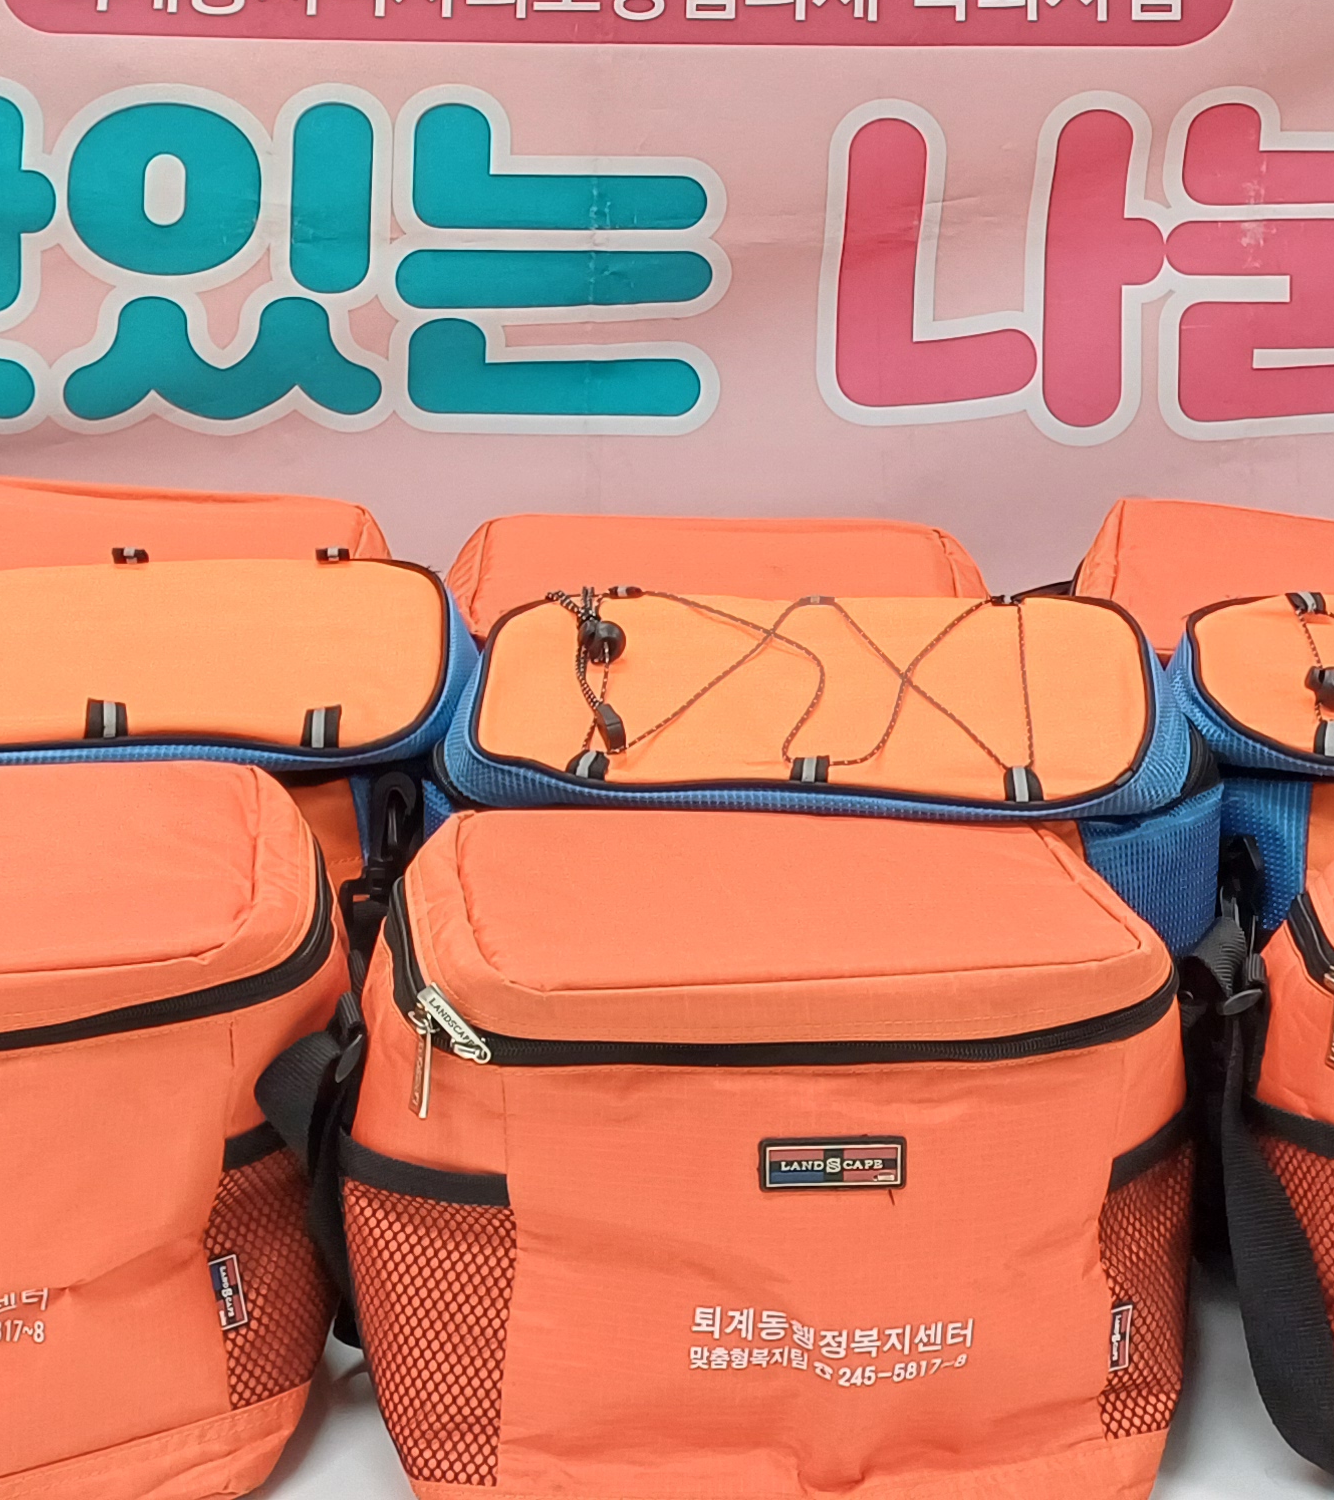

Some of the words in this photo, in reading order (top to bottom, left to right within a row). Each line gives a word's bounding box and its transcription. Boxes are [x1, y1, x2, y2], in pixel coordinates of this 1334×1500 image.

[780, 1157, 884, 1174] LANDSCAPE
[691, 1305, 975, 1359] 퇴계동행정복지센터
[688, 1345, 809, 1371] 맞춤형복지팀
[837, 1352, 968, 1388] 245-5817~8
